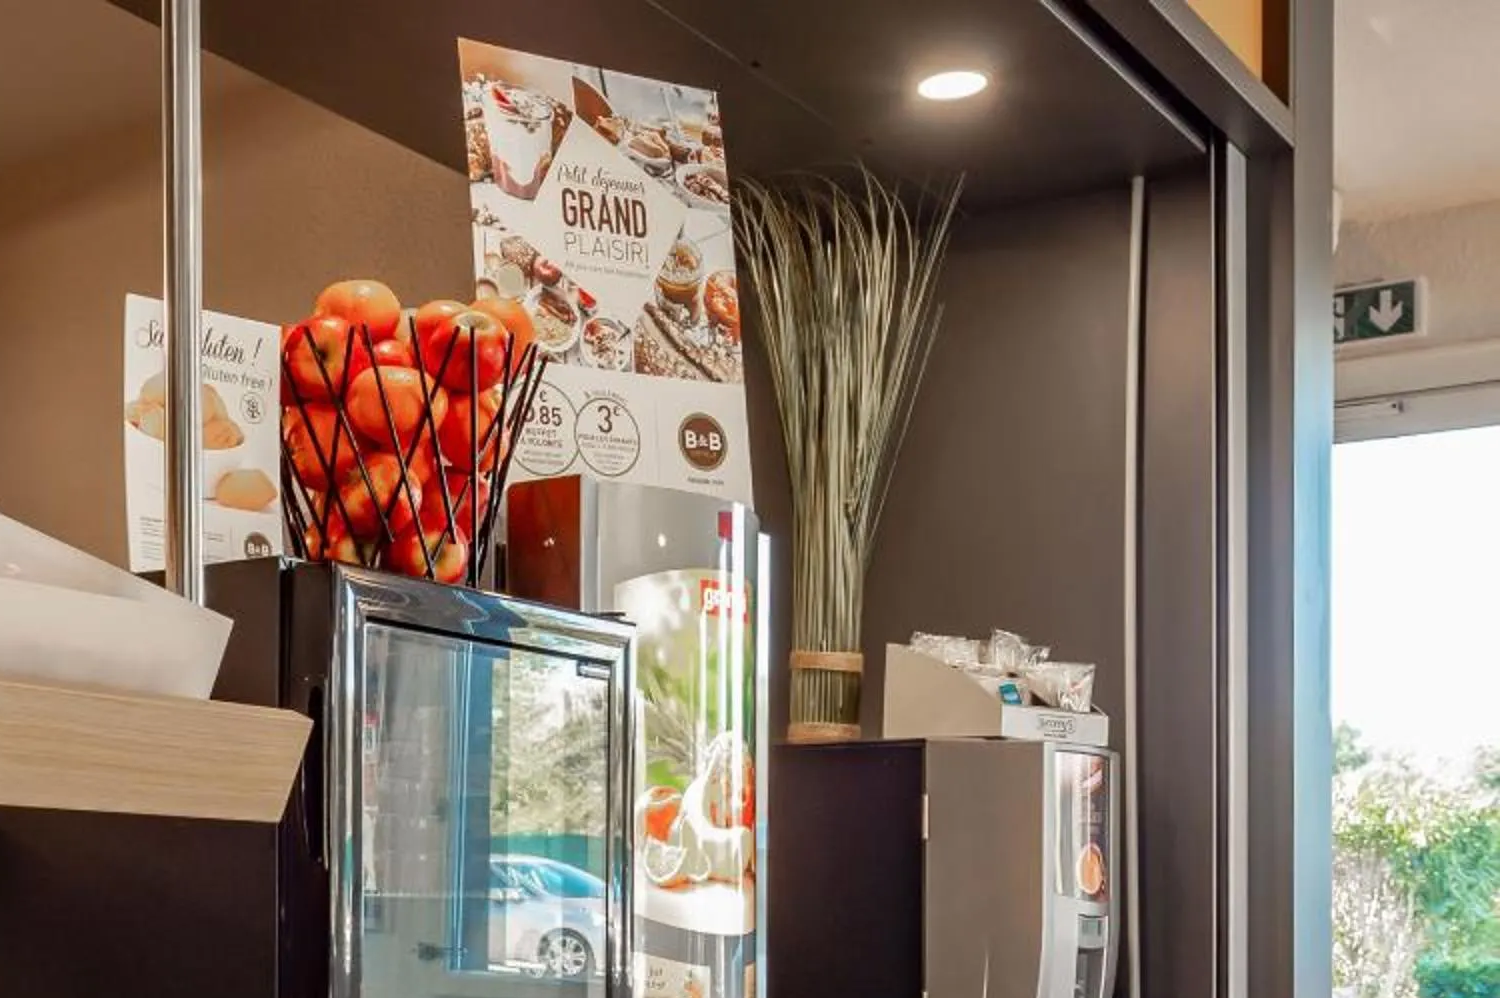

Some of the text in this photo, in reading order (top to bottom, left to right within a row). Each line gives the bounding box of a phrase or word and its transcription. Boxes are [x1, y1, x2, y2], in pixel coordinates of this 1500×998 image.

[561, 187, 647, 238] GRAND
[201, 327, 245, 365] luten
[684, 429, 722, 451] B&B
